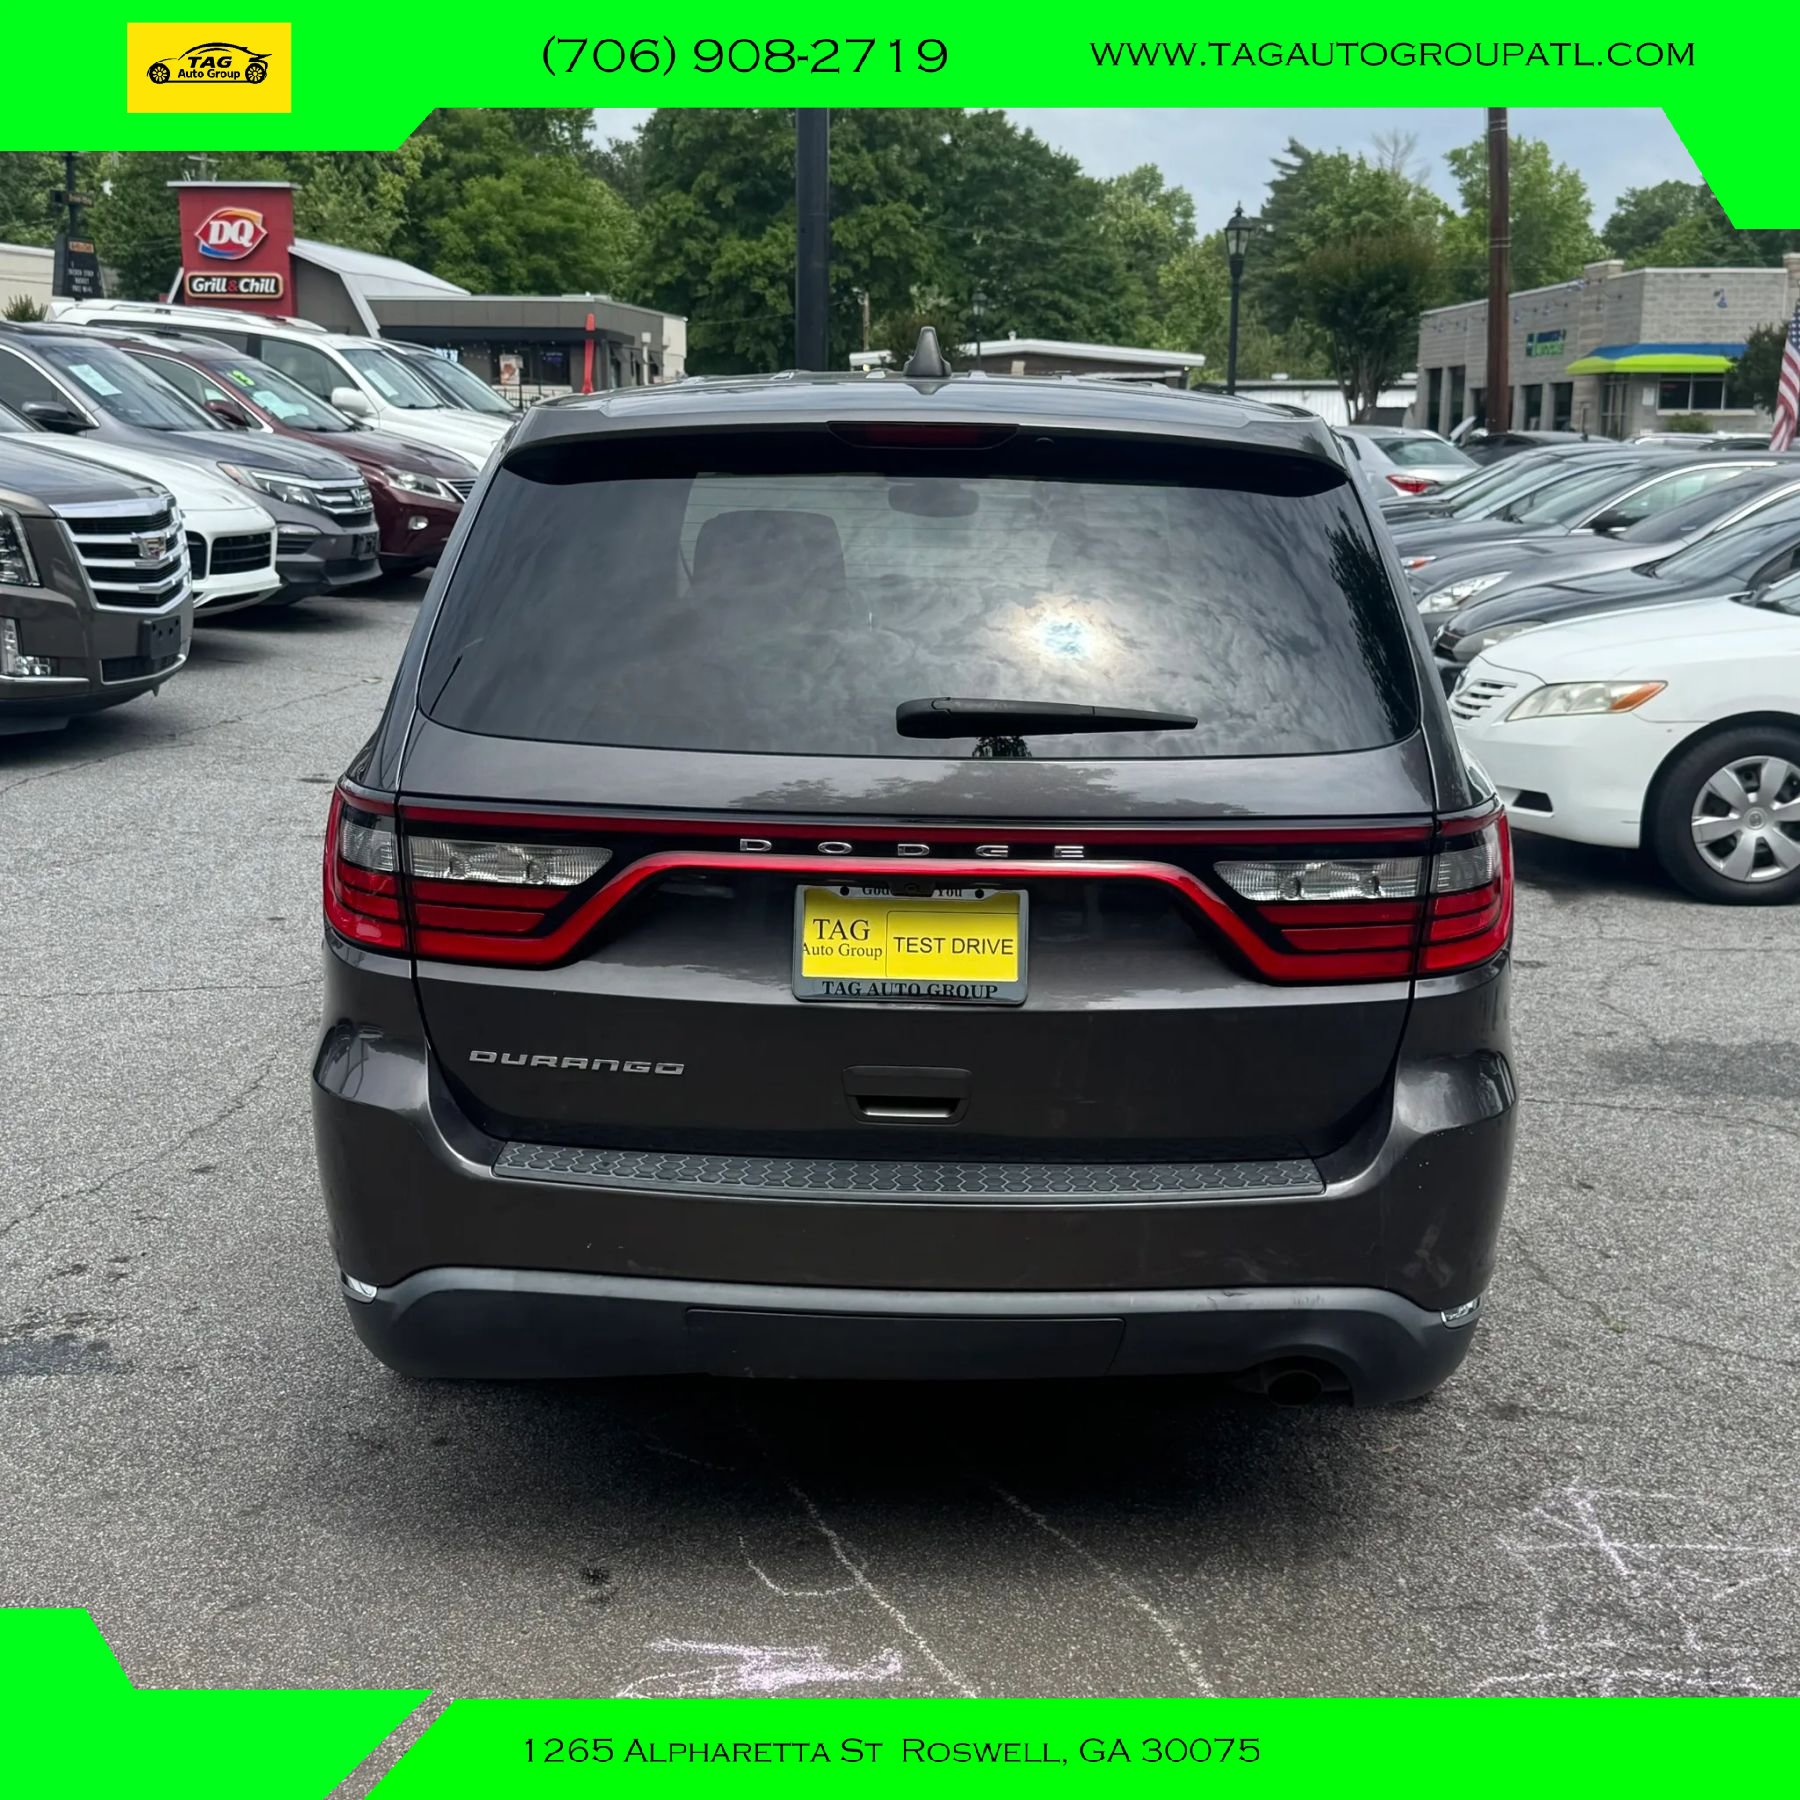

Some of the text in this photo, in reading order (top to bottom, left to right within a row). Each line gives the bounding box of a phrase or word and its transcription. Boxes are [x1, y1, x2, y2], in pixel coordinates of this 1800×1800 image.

[208, 218, 255, 248] DQ
[739, 838, 1085, 859] DODGE
[812, 918, 871, 941] TAG
[838, 943, 883, 961] Group
[893, 936, 1014, 956] TEST DRIVE
[822, 980, 998, 999] TAG AUTO GROUP
[468, 1050, 685, 1076] DURANGO
